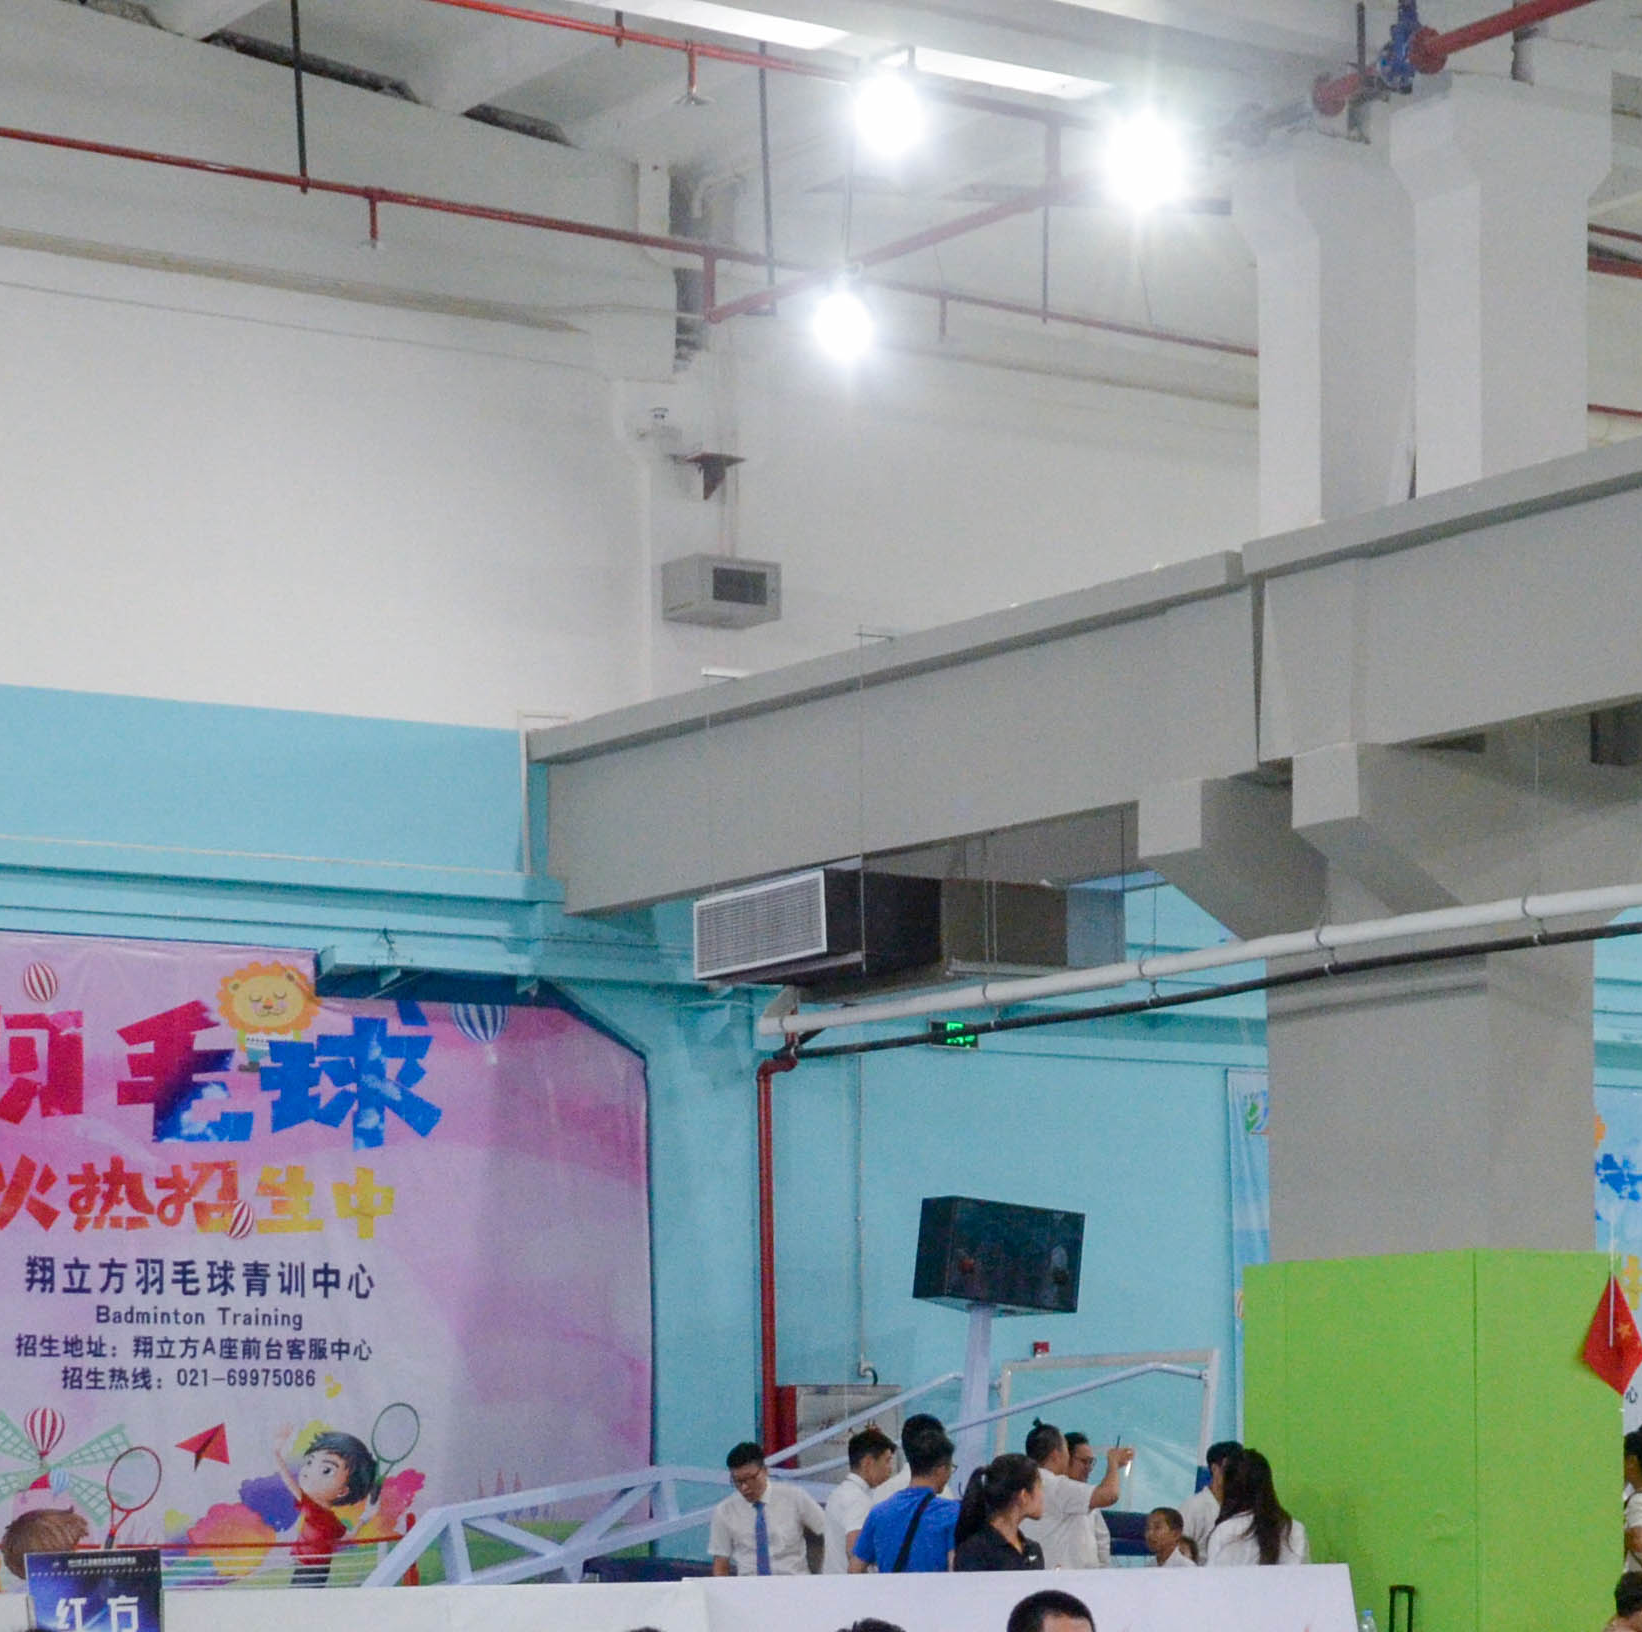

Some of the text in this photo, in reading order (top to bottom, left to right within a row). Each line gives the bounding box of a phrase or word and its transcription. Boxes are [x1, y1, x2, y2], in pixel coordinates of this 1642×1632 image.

[25, 1255, 376, 1300] 翔立方羽毛球青训中心
[95, 1306, 304, 1331] Badminton Training
